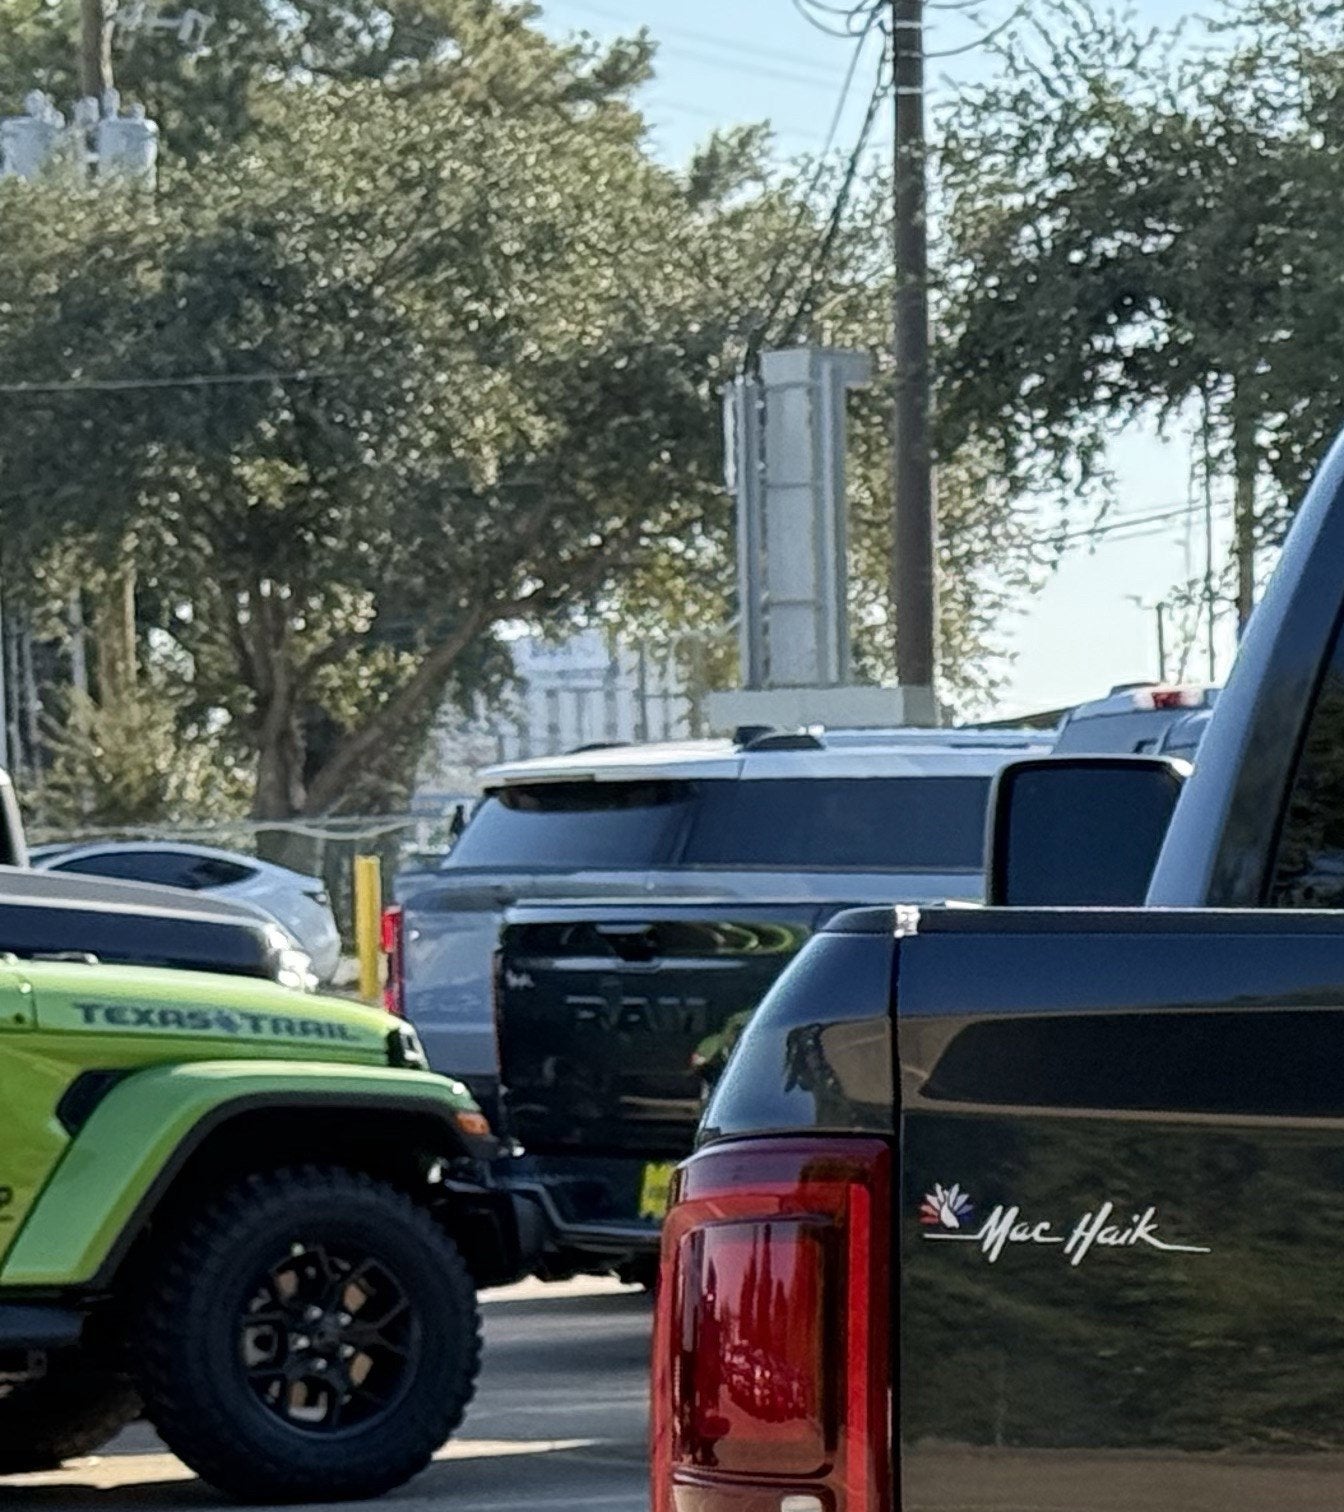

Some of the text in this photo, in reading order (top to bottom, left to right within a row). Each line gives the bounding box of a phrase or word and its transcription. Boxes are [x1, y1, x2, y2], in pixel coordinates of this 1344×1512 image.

[74, 1001, 362, 1043] TEXAS TRAIL
[923, 1201, 1211, 1266] Mac Haik
